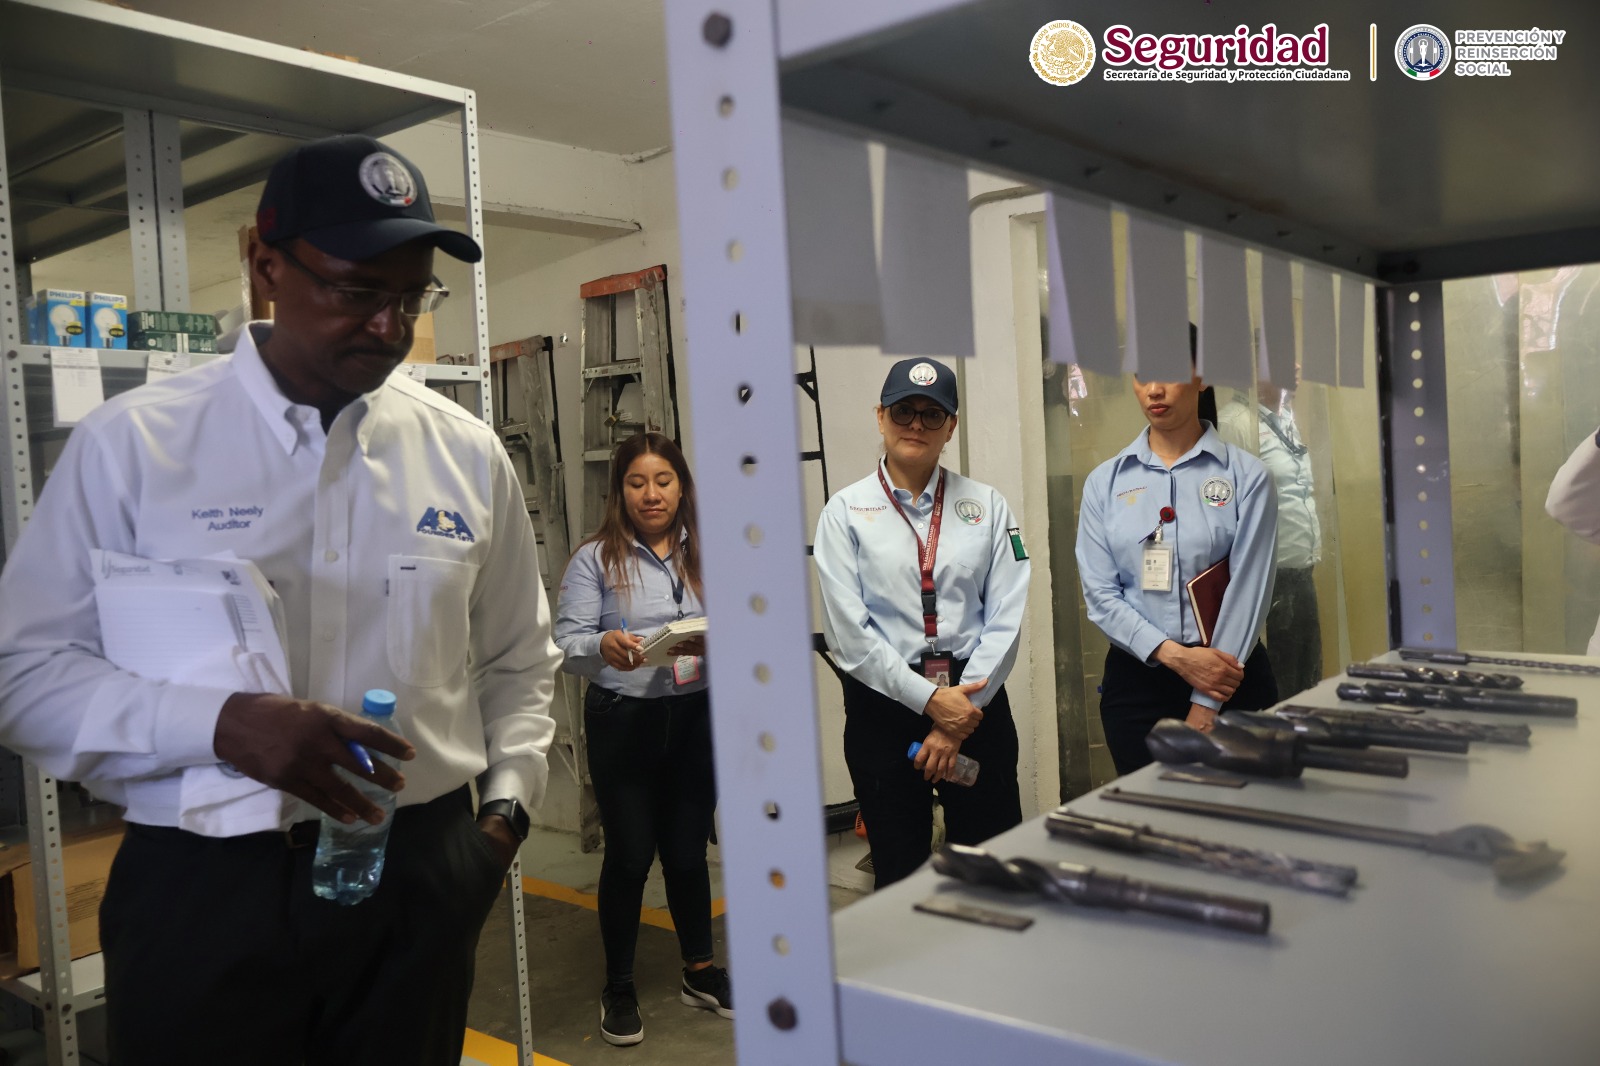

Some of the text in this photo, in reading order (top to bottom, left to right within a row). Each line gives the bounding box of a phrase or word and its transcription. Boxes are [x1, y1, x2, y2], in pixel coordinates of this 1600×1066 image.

[49, 291, 82, 300] PHILIPS
[94, 294, 124, 304] PHILIPS
[191, 505, 264, 520] Keith Neely
[207, 518, 252, 532] Auditor
